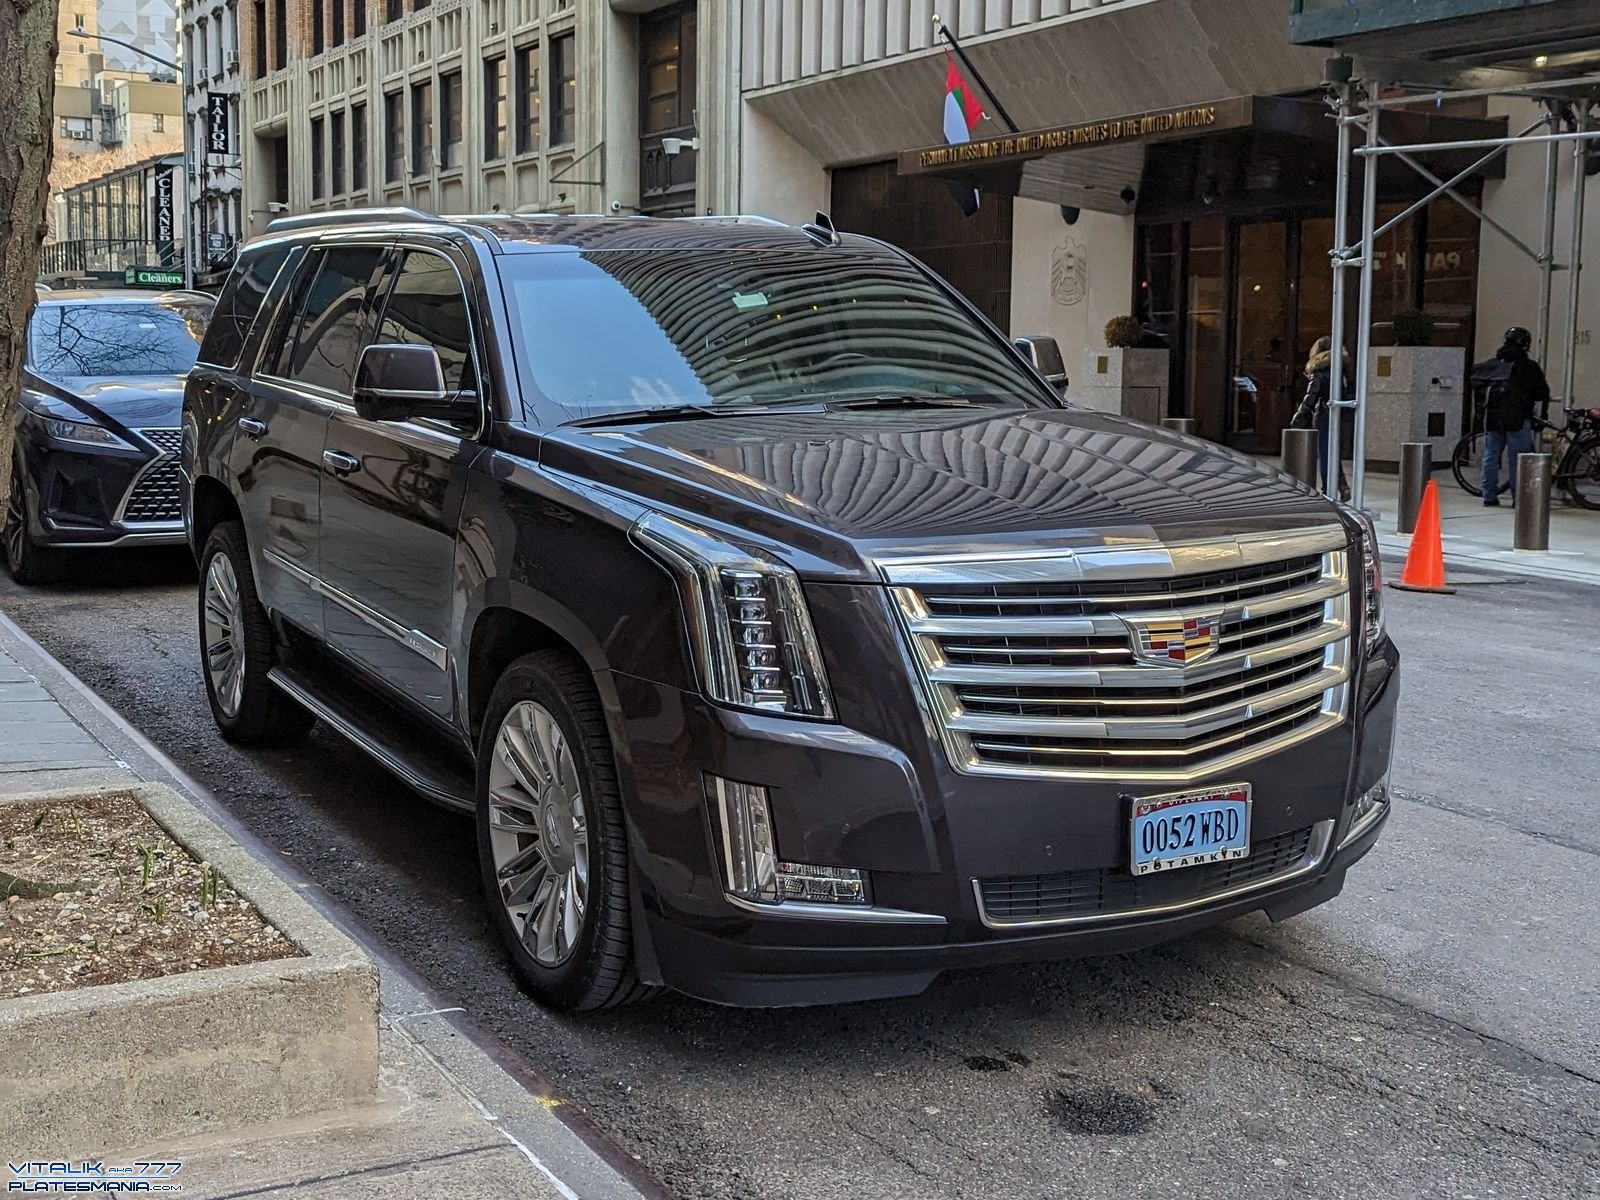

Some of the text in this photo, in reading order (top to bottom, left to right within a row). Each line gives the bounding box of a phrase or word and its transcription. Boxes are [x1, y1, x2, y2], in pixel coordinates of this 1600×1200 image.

[211, 96, 226, 151] TAILOR
[1001, 139, 1014, 155] THE
[1016, 135, 1044, 153] UNITED
[1044, 130, 1067, 149] ARAB
[1067, 124, 1108, 145] EMIRATES
[1110, 121, 1121, 139] TO
[1123, 119, 1138, 137] THE
[1140, 113, 1173, 134] UNITED
[1174, 106, 1216, 129] NATIONS
[139, 272, 182, 284] Cleaners
